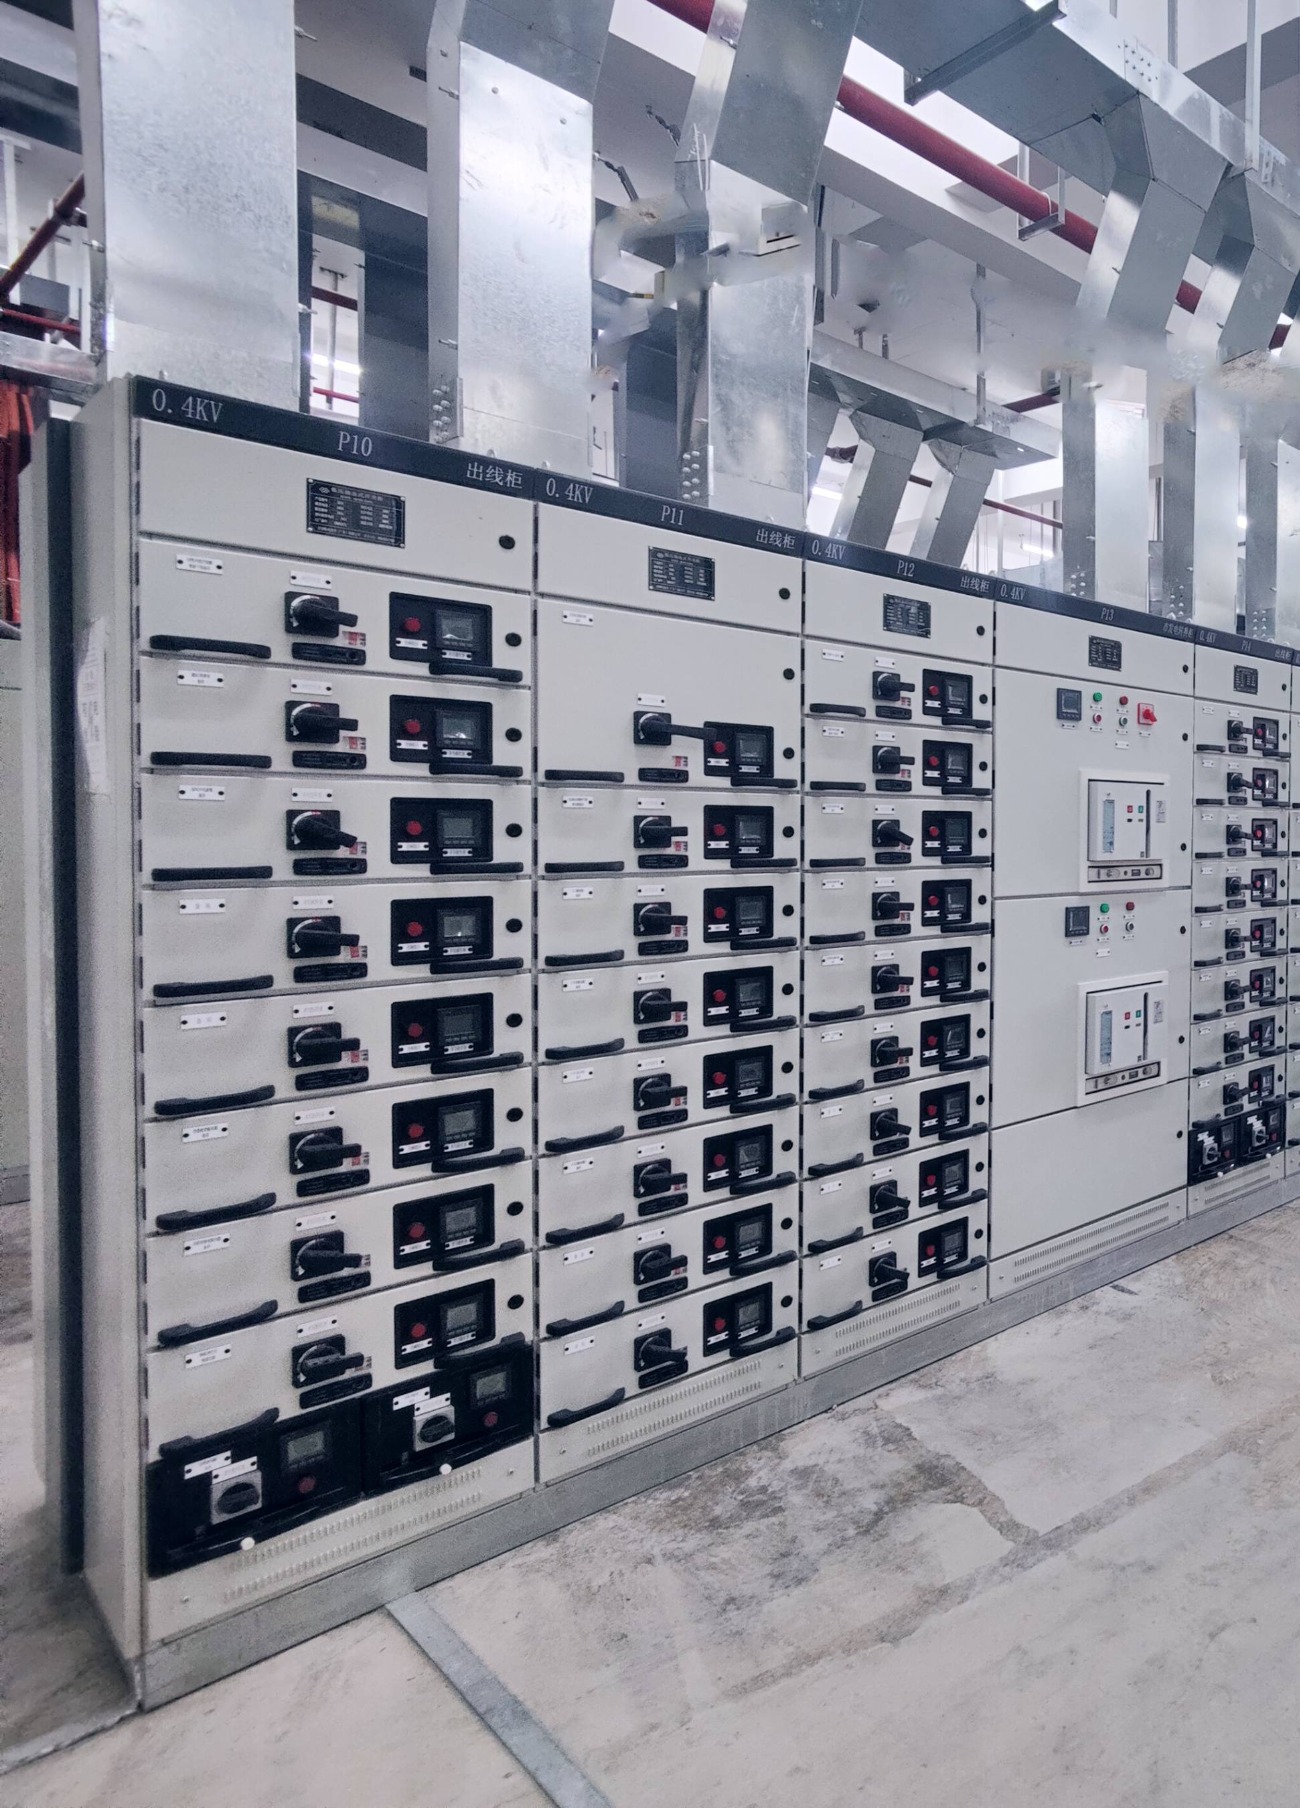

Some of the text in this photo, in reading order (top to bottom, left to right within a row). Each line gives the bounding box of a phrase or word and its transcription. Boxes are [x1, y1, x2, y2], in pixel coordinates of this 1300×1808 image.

[152, 388, 523, 490] 0.4KV P10 出线柜
[546, 477, 795, 550] 0.4KV P11 出线柜
[811, 540, 990, 593] 0.4KV P12 出线柜
[1101, 607, 1115, 621] P13
